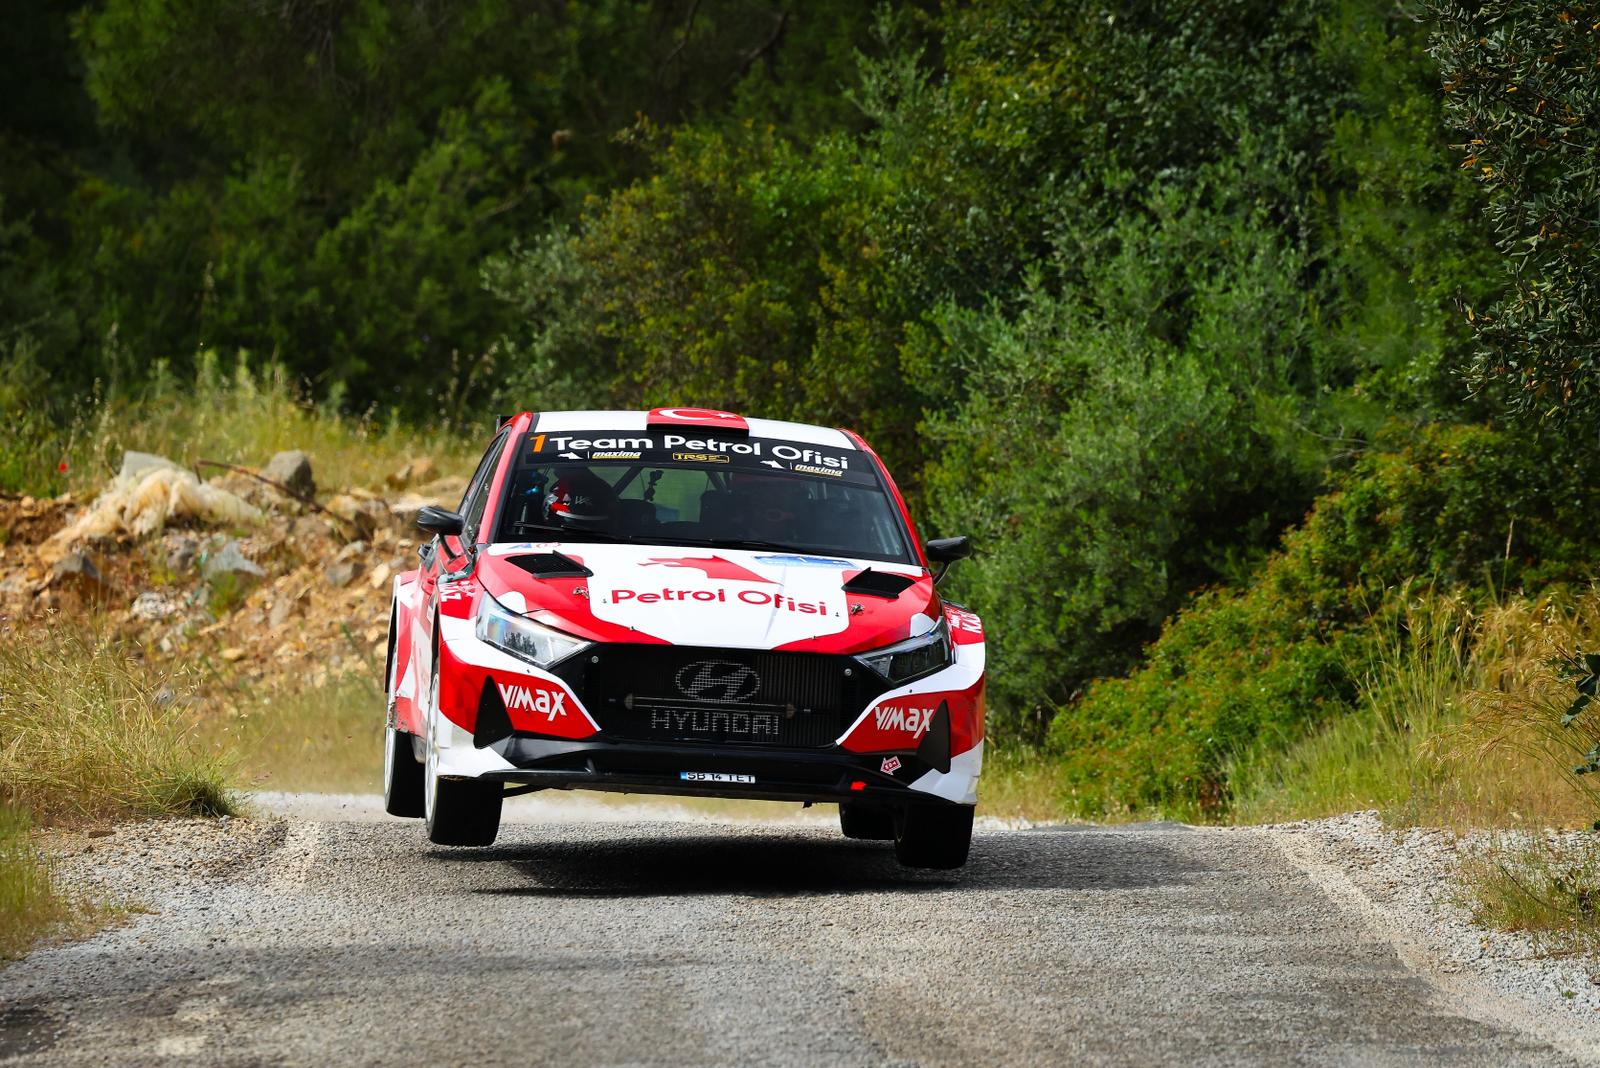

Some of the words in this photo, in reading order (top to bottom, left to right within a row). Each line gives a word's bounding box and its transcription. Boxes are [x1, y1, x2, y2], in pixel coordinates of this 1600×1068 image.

[530, 434, 547, 453] 1
[549, 436, 654, 451] Team
[663, 435, 761, 456] Petrol
[771, 445, 849, 470] Ofisi
[592, 450, 643, 459] maxima
[794, 464, 844, 477] maxima
[611, 587, 726, 605] Petrol
[737, 590, 828, 616] Ofisi
[651, 709, 779, 735] HYUNDAI
